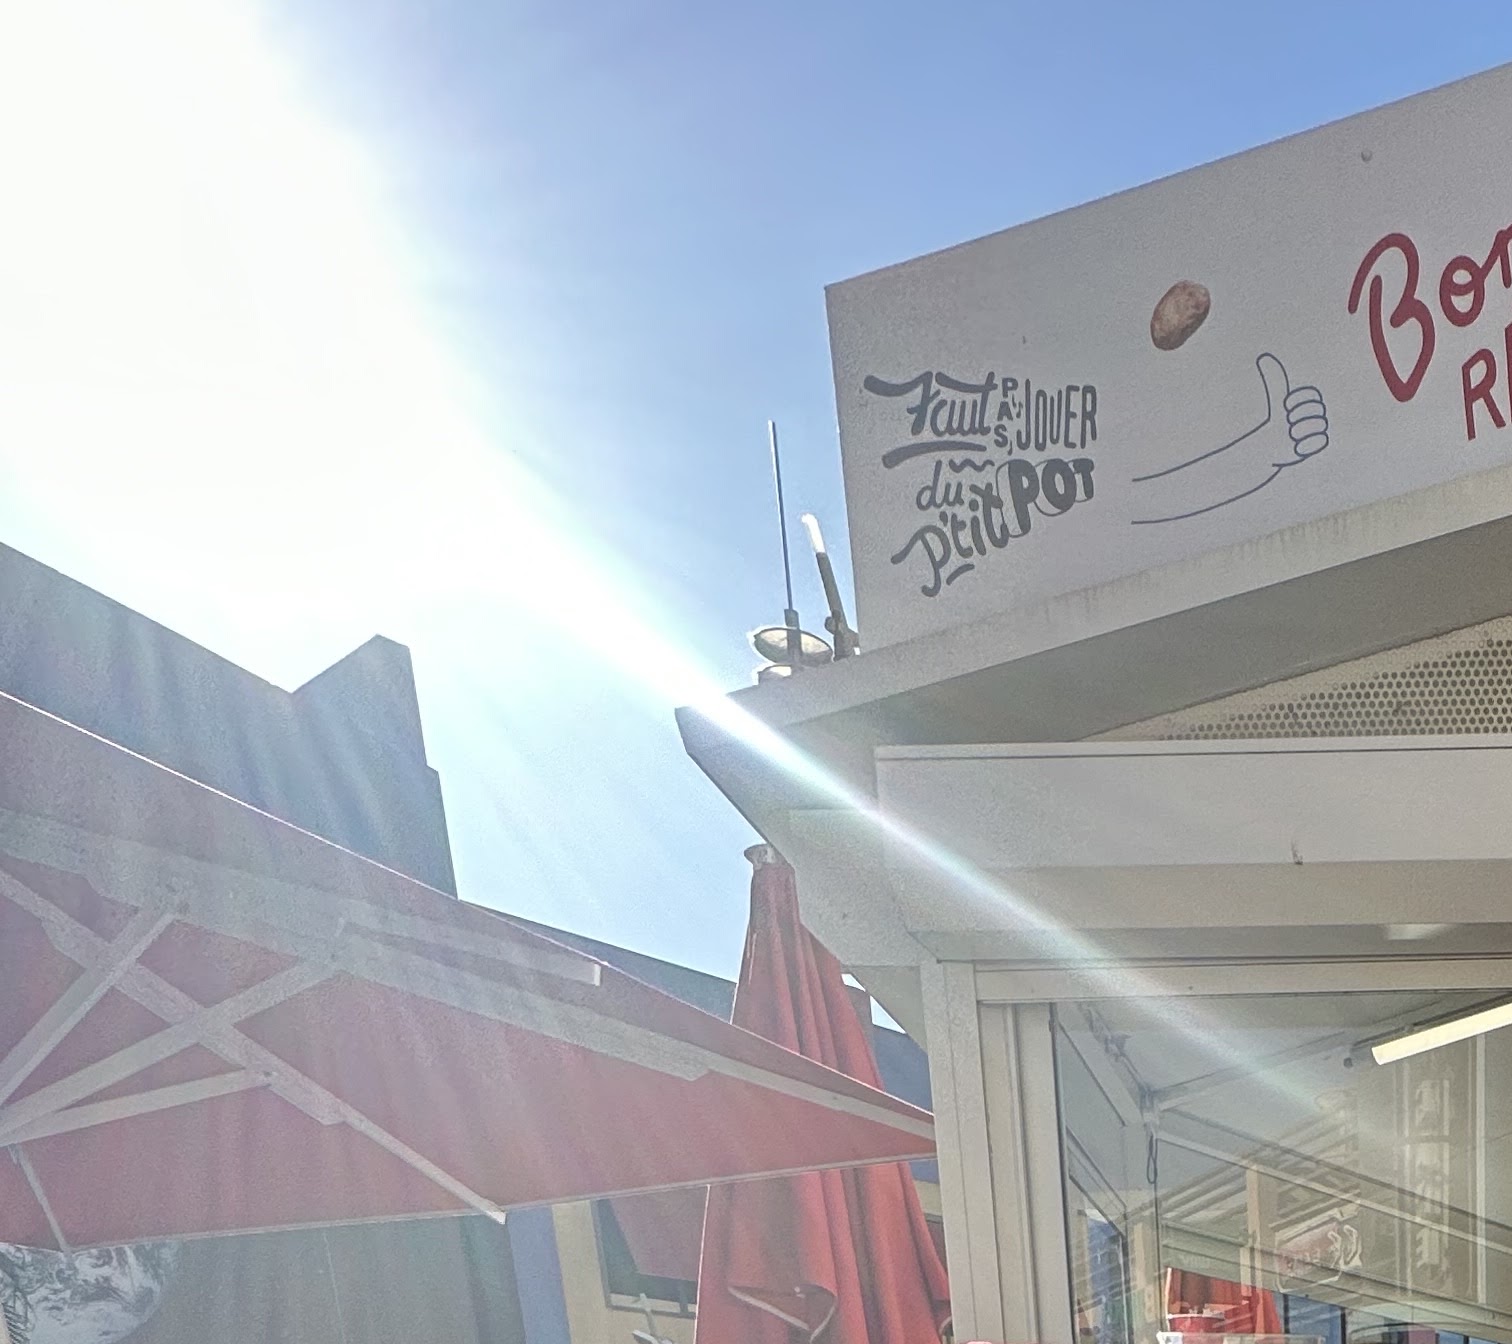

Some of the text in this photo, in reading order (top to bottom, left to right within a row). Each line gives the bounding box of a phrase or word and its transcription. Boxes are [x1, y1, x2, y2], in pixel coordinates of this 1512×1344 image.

[863, 371, 998, 437] Faut
[1016, 378, 1098, 452] JOUER
[997, 457, 1095, 539] POT
